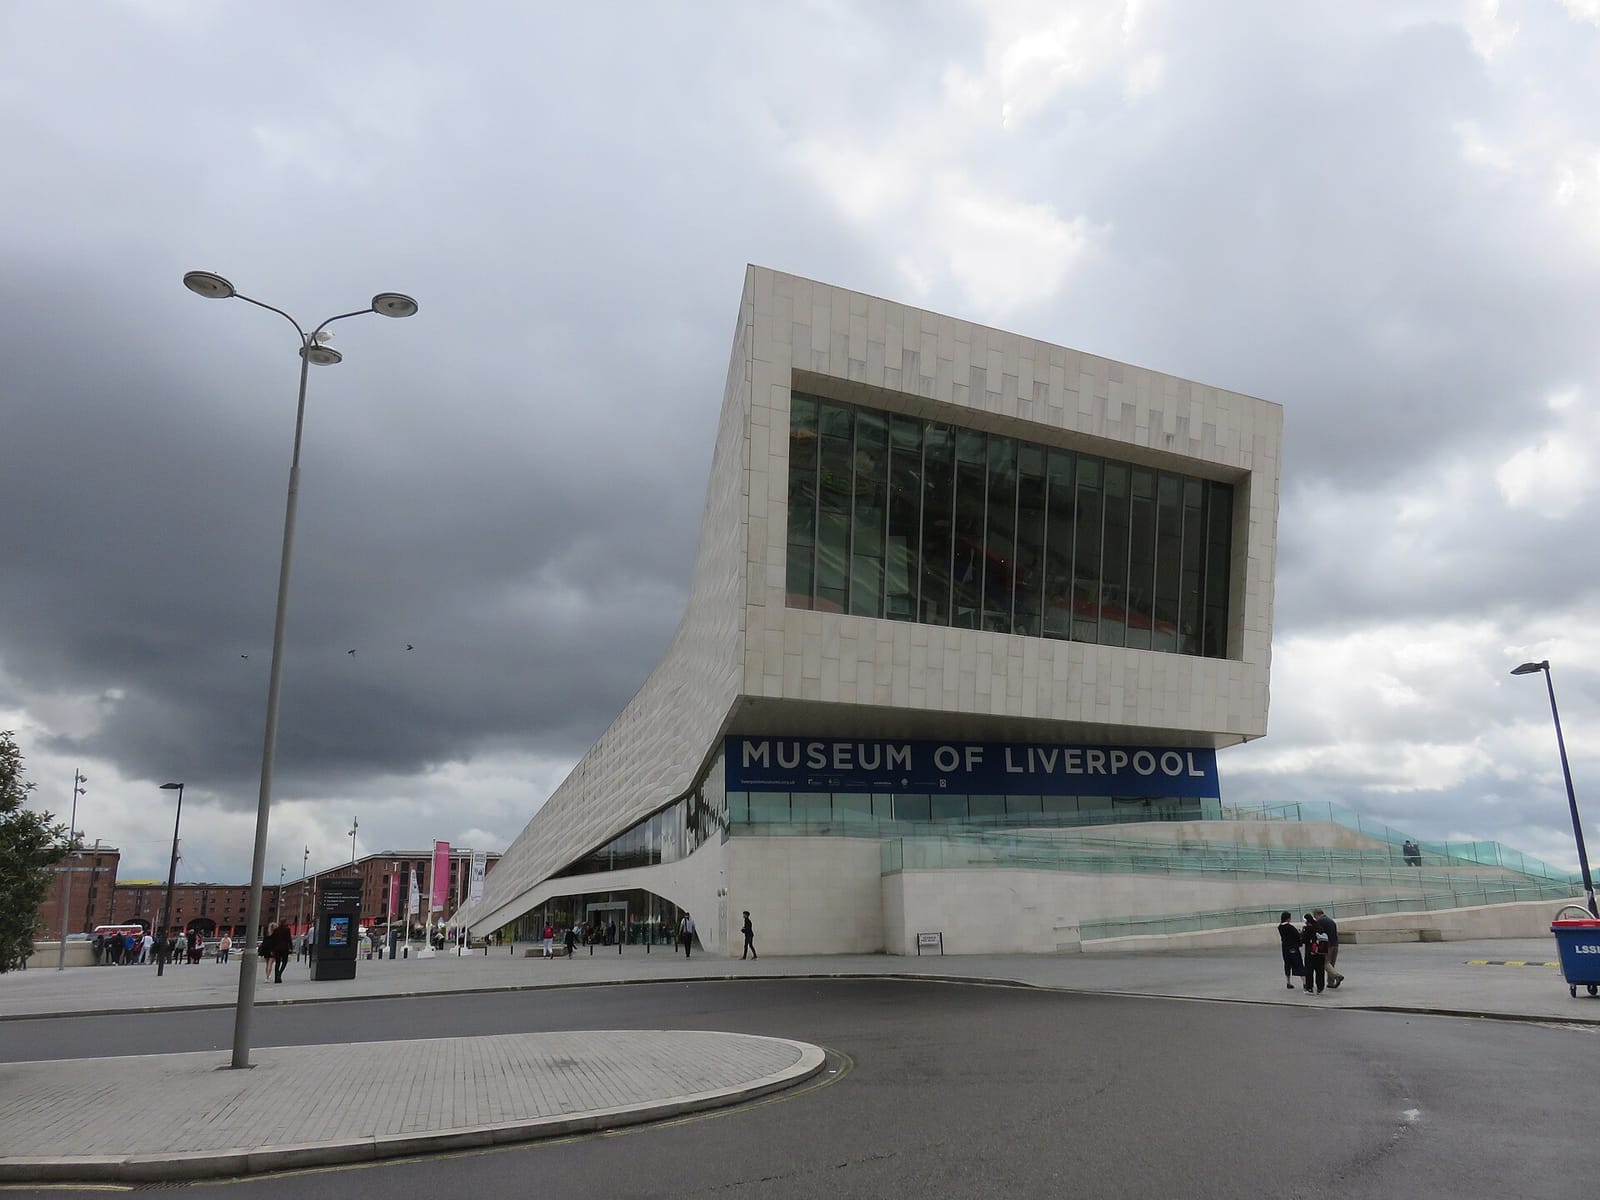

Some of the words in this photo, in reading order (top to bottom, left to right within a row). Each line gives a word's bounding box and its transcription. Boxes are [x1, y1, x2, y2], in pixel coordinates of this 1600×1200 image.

[742, 740, 912, 771] MUSEUM
[934, 745, 984, 772] OF
[1004, 747, 1205, 777] LIVERPOOL
